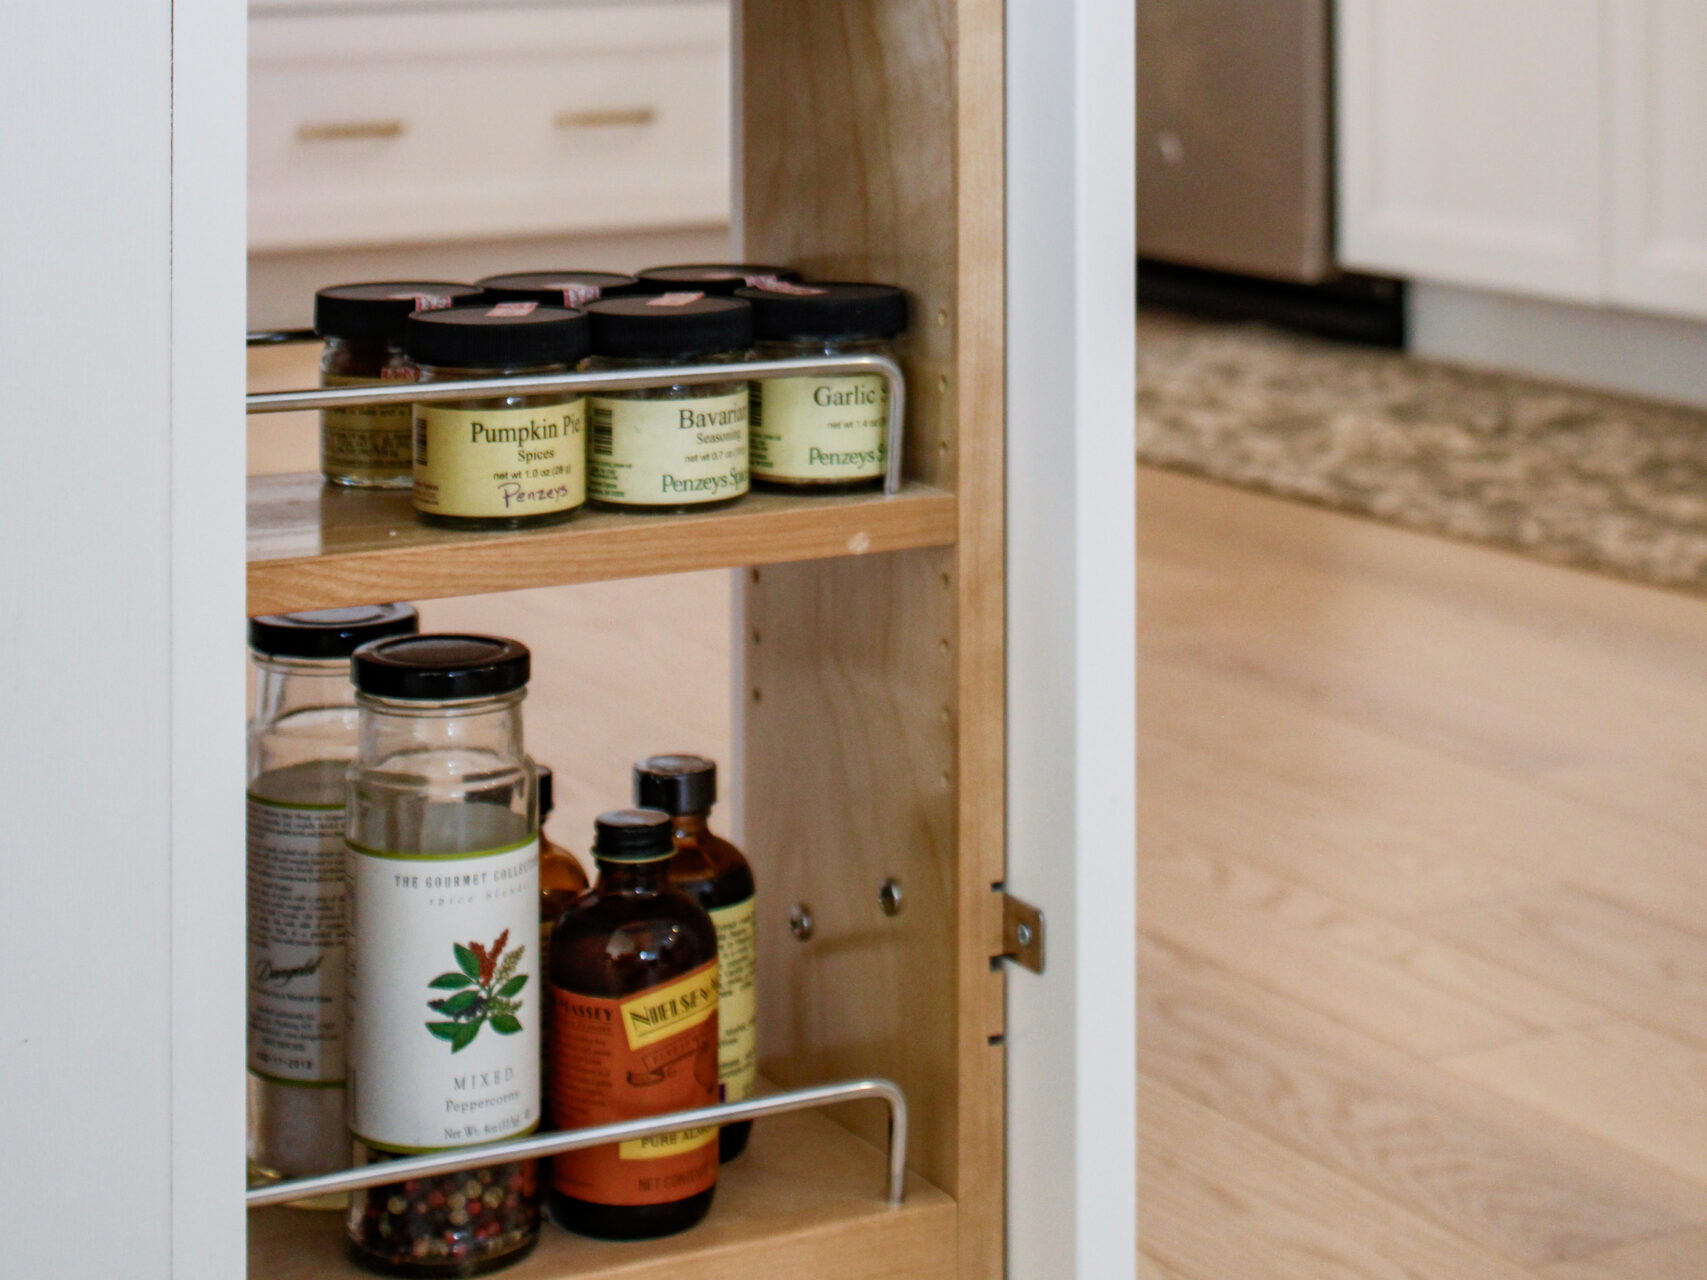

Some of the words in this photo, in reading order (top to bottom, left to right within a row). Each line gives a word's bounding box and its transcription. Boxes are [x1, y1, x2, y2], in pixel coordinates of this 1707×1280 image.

[813, 385, 876, 407] Garlic
[471, 419, 558, 448] Pumpkin
[562, 414, 581, 437] Pie
[517, 449, 555, 464] Spices
[809, 447, 875, 470] Penzeys
[493, 471, 508, 481] net
[511, 470, 522, 480] wt
[662, 472, 727, 495] Penzeys
[497, 482, 568, 509] Penzeys
[394, 875, 418, 889] THE
[425, 872, 488, 889] GOURMET
[453, 1067, 513, 1091] MIXED
[446, 1091, 519, 1113] Peppercorns
[641, 1131, 677, 1148] PURE
